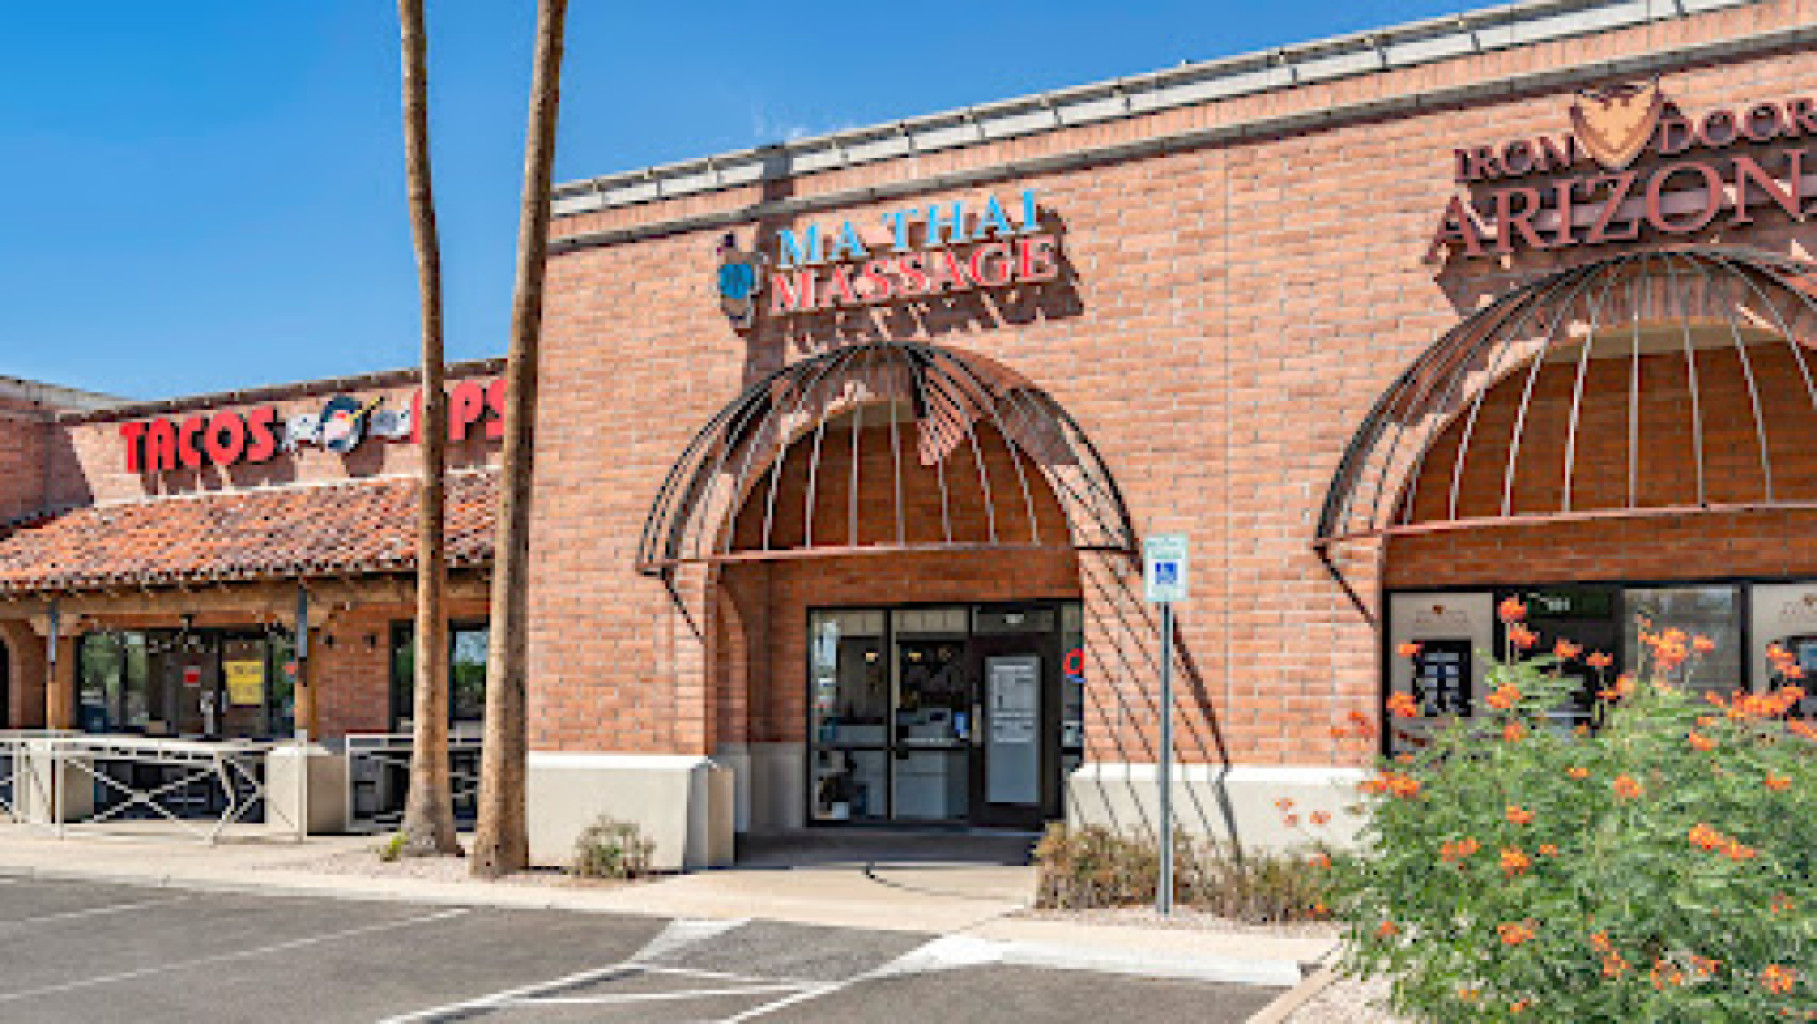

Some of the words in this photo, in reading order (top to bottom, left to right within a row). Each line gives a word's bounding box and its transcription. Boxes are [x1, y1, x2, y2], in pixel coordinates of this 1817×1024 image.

[1453, 135, 1576, 183] IRON
[776, 219, 868, 269] MA
[883, 188, 1042, 252] THAI
[1423, 147, 1817, 266] ARIZON
[769, 234, 1060, 315] MASSAGE
[119, 405, 278, 475] TACOS
